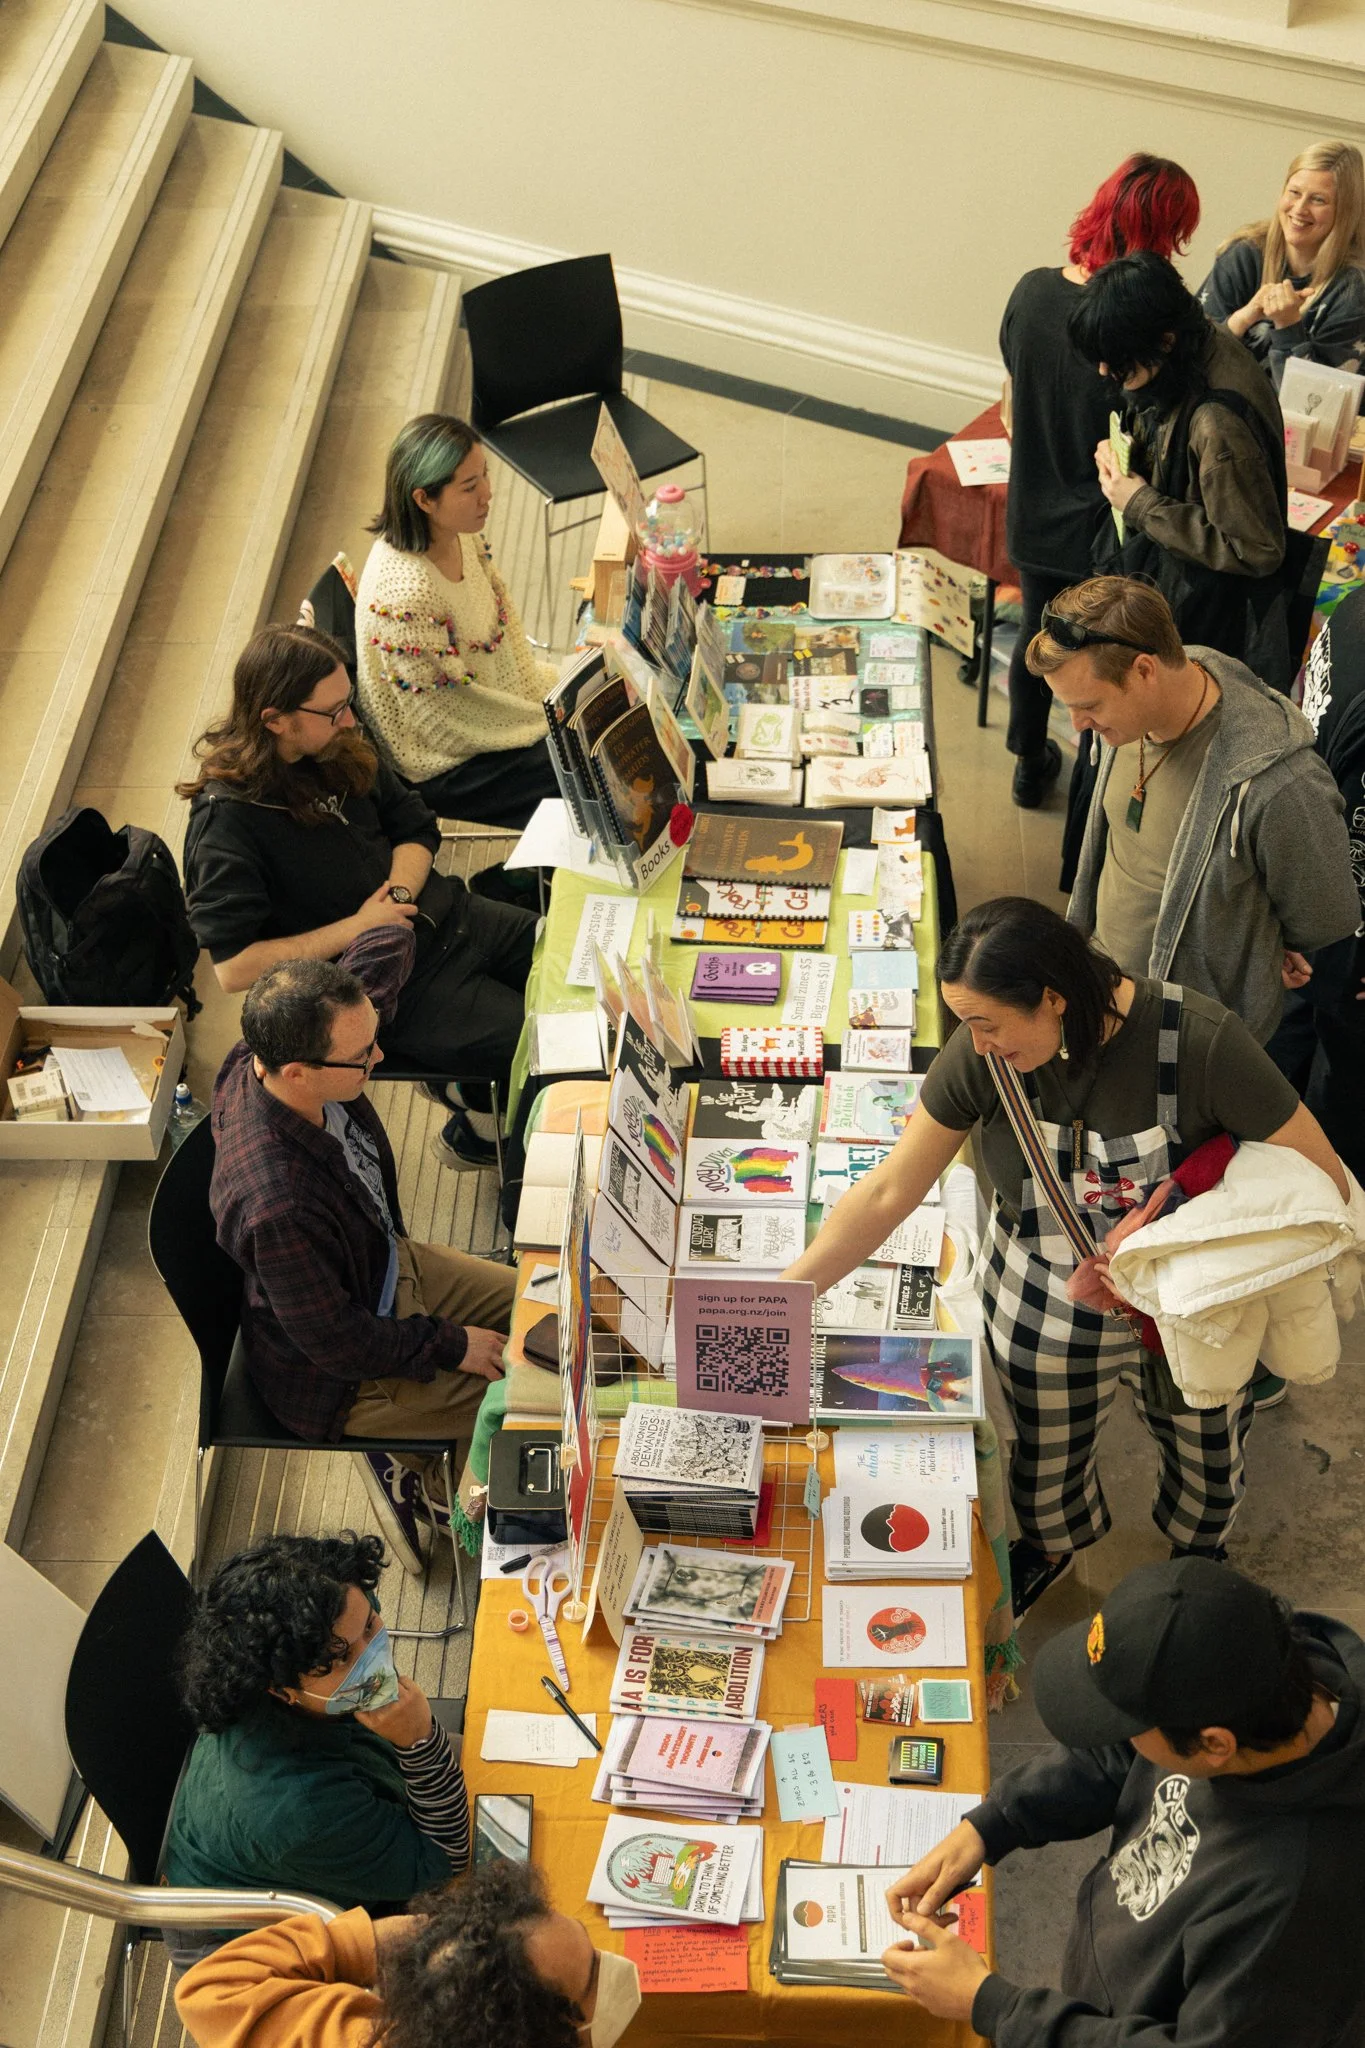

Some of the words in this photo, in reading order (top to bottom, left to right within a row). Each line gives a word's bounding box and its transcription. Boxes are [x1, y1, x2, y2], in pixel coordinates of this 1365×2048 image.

[639, 840, 672, 881] Books
[603, 902, 621, 928] Joseph
[703, 956, 722, 981] Goths
[798, 957, 813, 969] $5
[816, 961, 831, 978] $10
[797, 971, 810, 993] zines
[814, 979, 828, 1003] zines
[789, 995, 806, 1020] Small
[810, 1004, 826, 1018] Big
[703, 1226, 714, 1248] DIARY
[690, 1249, 702, 1260] MY
[880, 1248, 894, 1260] $5
[911, 1251, 926, 1264] $3
[902, 1265, 912, 1283] ibis
[698, 1294, 720, 1303] sign
[759, 1296, 787, 1304] PAPA
[899, 1286, 910, 1313] private
[699, 1308, 786, 1317] papa.org.nz/join
[631, 1414, 649, 1466] ABOLITIONIST
[639, 1415, 660, 1467] DEMANDS:
[654, 1438, 662, 1447] THE
[656, 1448, 664, 1468] PRISONS
[662, 1418, 671, 1442] AOTEAROA
[864, 1443, 879, 1478] whats
[927, 1437, 936, 1472] abolition
[629, 1635, 654, 1664] FOR
[624, 1669, 647, 1684] IS
[725, 1647, 753, 1710] ABOLITION
[621, 1691, 643, 1701] A
[657, 1732, 672, 1756] PRISON
[666, 1724, 687, 1769] ABOLITIONIST
[679, 1733, 697, 1765] THOUGHTS
[918, 1744, 926, 1763] PRISONS
[801, 1751, 810, 1765] $12
[793, 1784, 805, 1807] ZINES
[718, 1845, 734, 1871] BETTER
[701, 1863, 716, 1880] THINK
[699, 1882, 710, 1890] TO
[710, 1872, 727, 1904] SOMETHING
[693, 1891, 709, 1912] DARING
[708, 1906, 719, 1914] OF
[825, 1905, 837, 1922] PAPA
